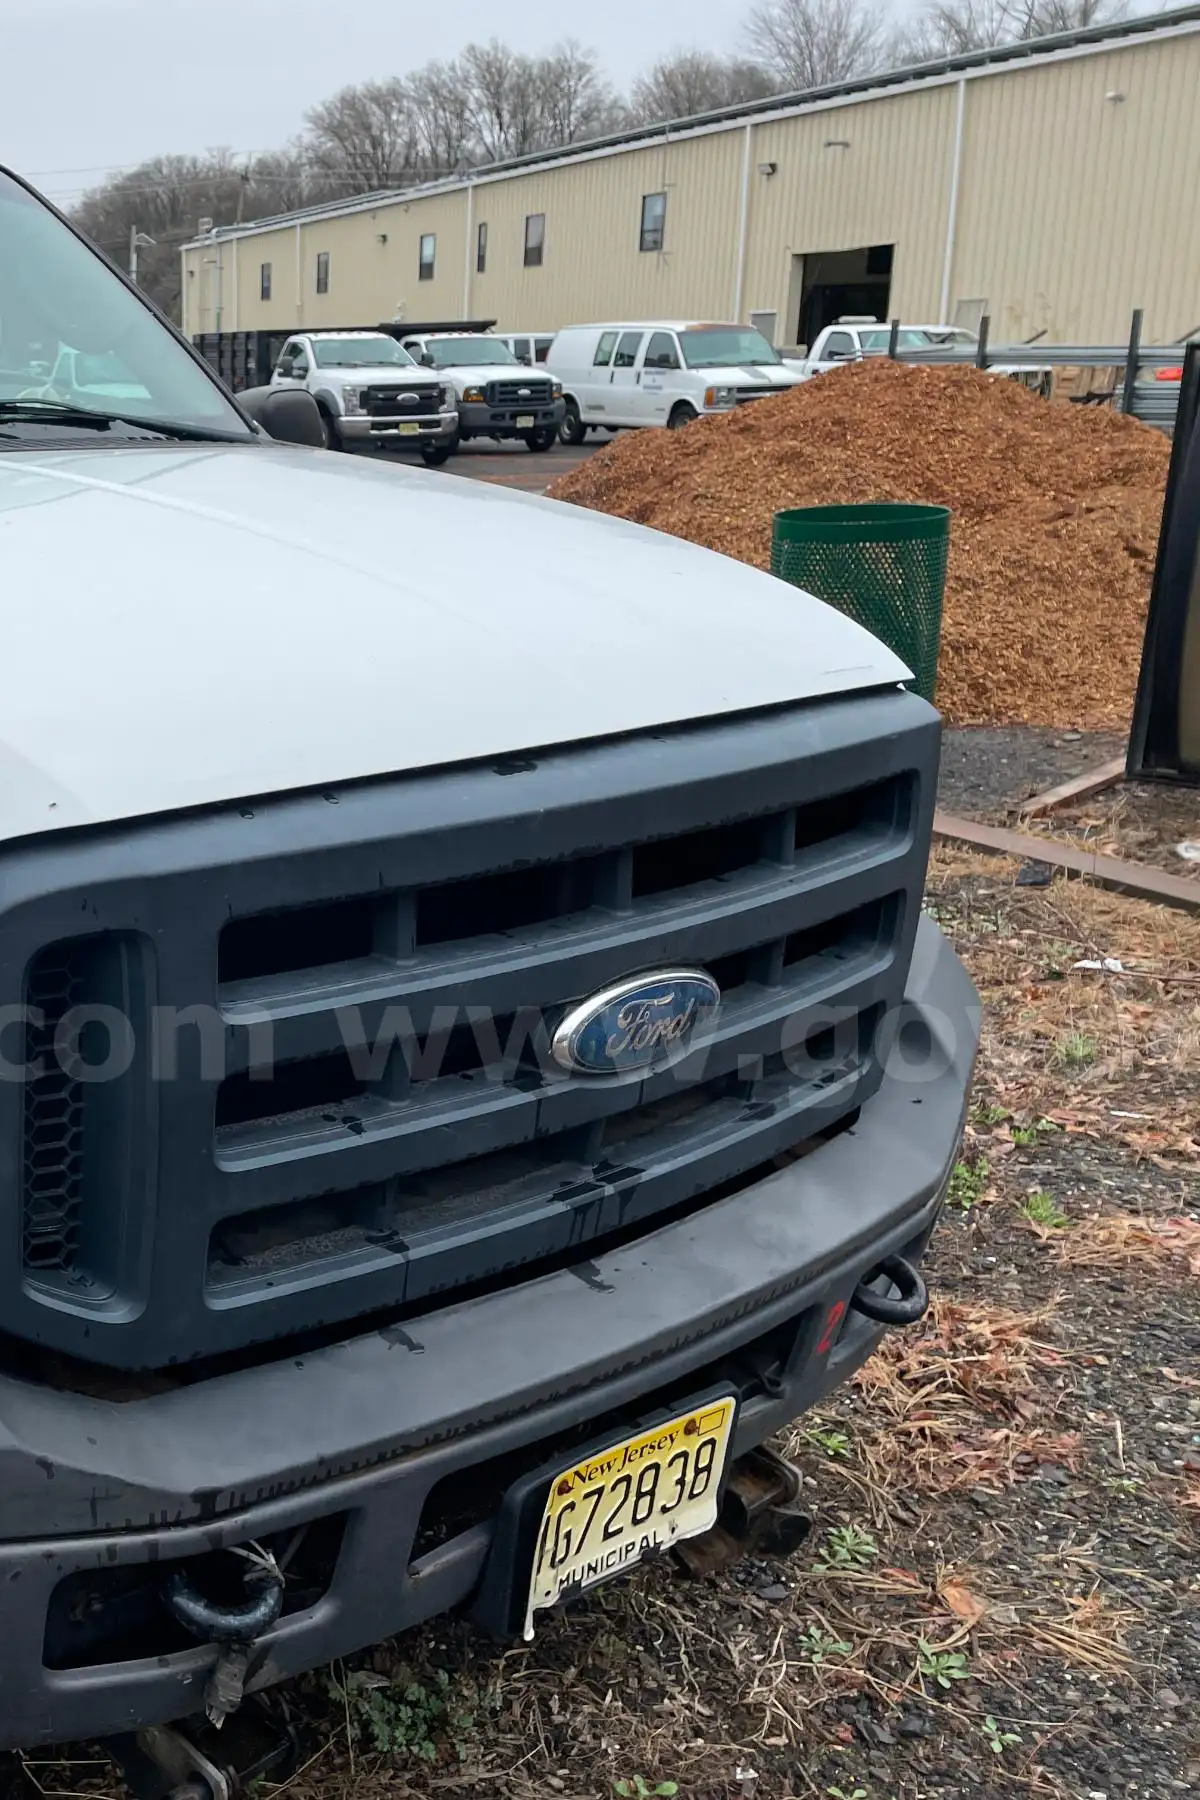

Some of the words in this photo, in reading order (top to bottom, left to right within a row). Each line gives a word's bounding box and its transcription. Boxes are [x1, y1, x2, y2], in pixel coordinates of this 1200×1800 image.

[605, 991, 695, 1058] Ford
[569, 1457, 617, 1491] New
[617, 1428, 680, 1474] Jersey
[558, 1530, 663, 1587] MUNICIPAL
